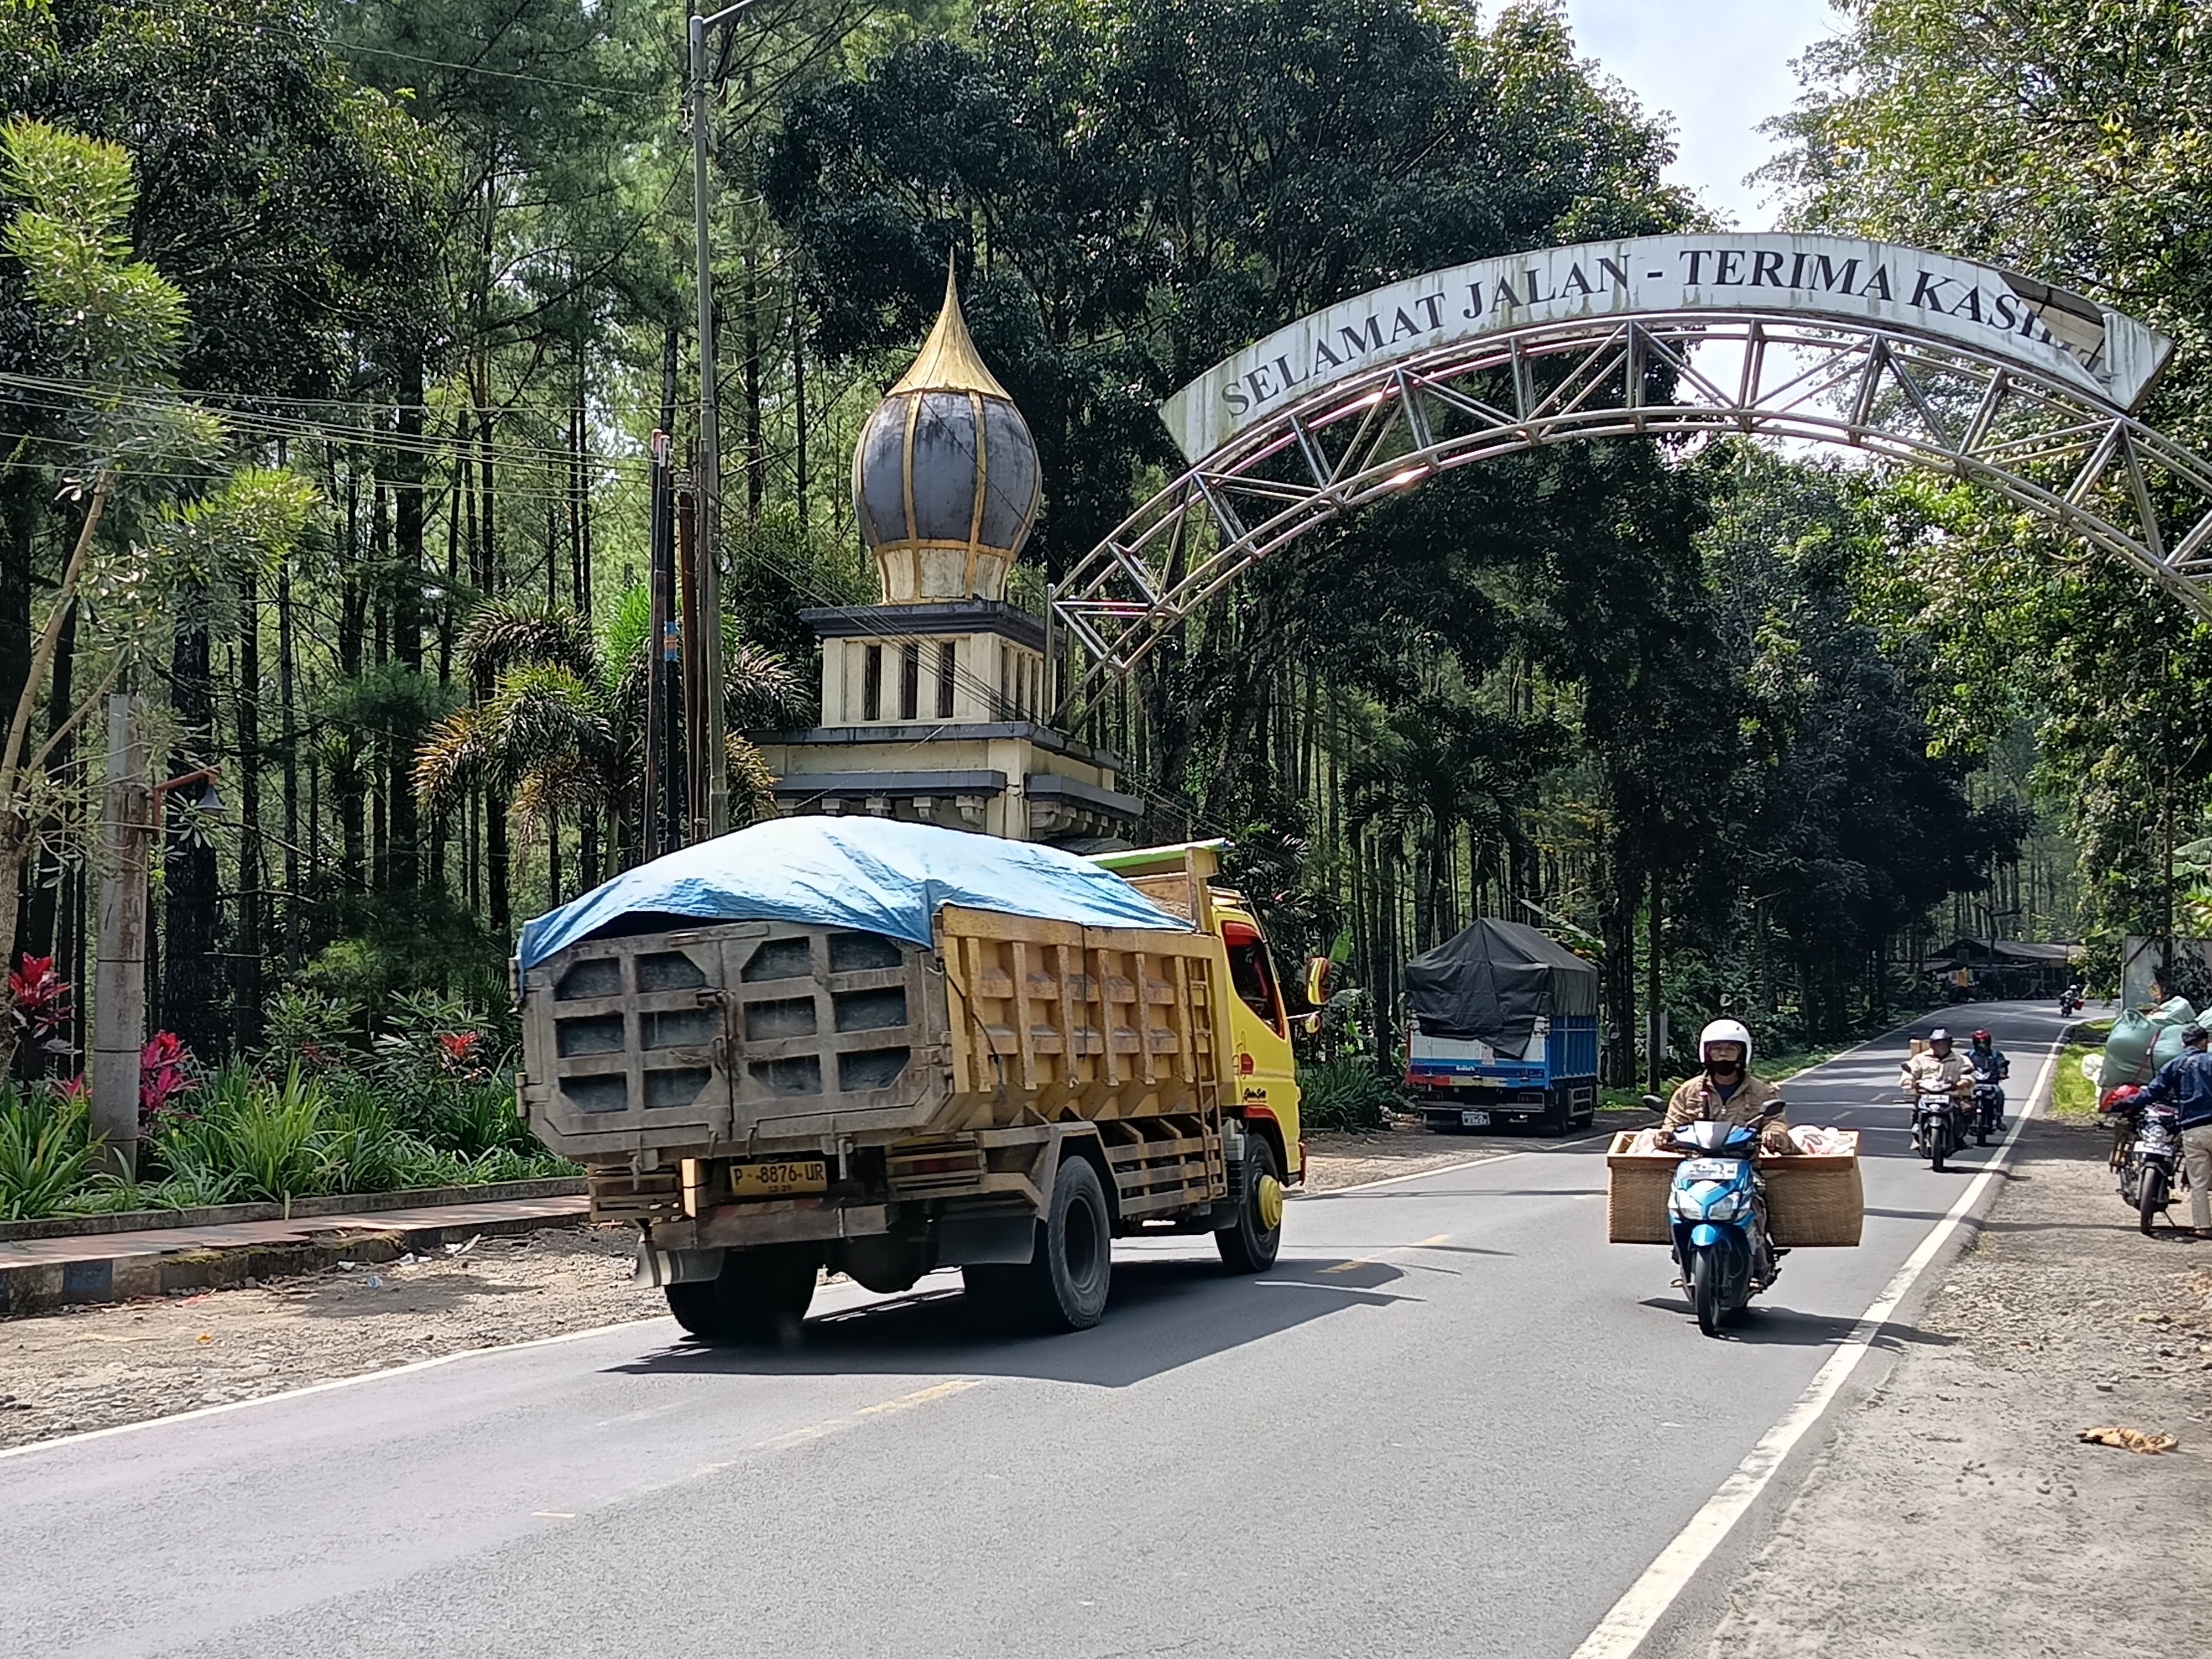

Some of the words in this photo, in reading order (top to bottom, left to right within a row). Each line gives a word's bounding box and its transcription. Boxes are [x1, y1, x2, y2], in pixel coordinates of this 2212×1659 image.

[1222, 291, 1447, 419] SELAMAT
[1463, 254, 1632, 320] JALAN
[1679, 250, 1892, 302] TERIMA
[733, 1168, 743, 1186] P
[760, 1165, 797, 1183] 8876
[805, 1164, 825, 1181] UR
